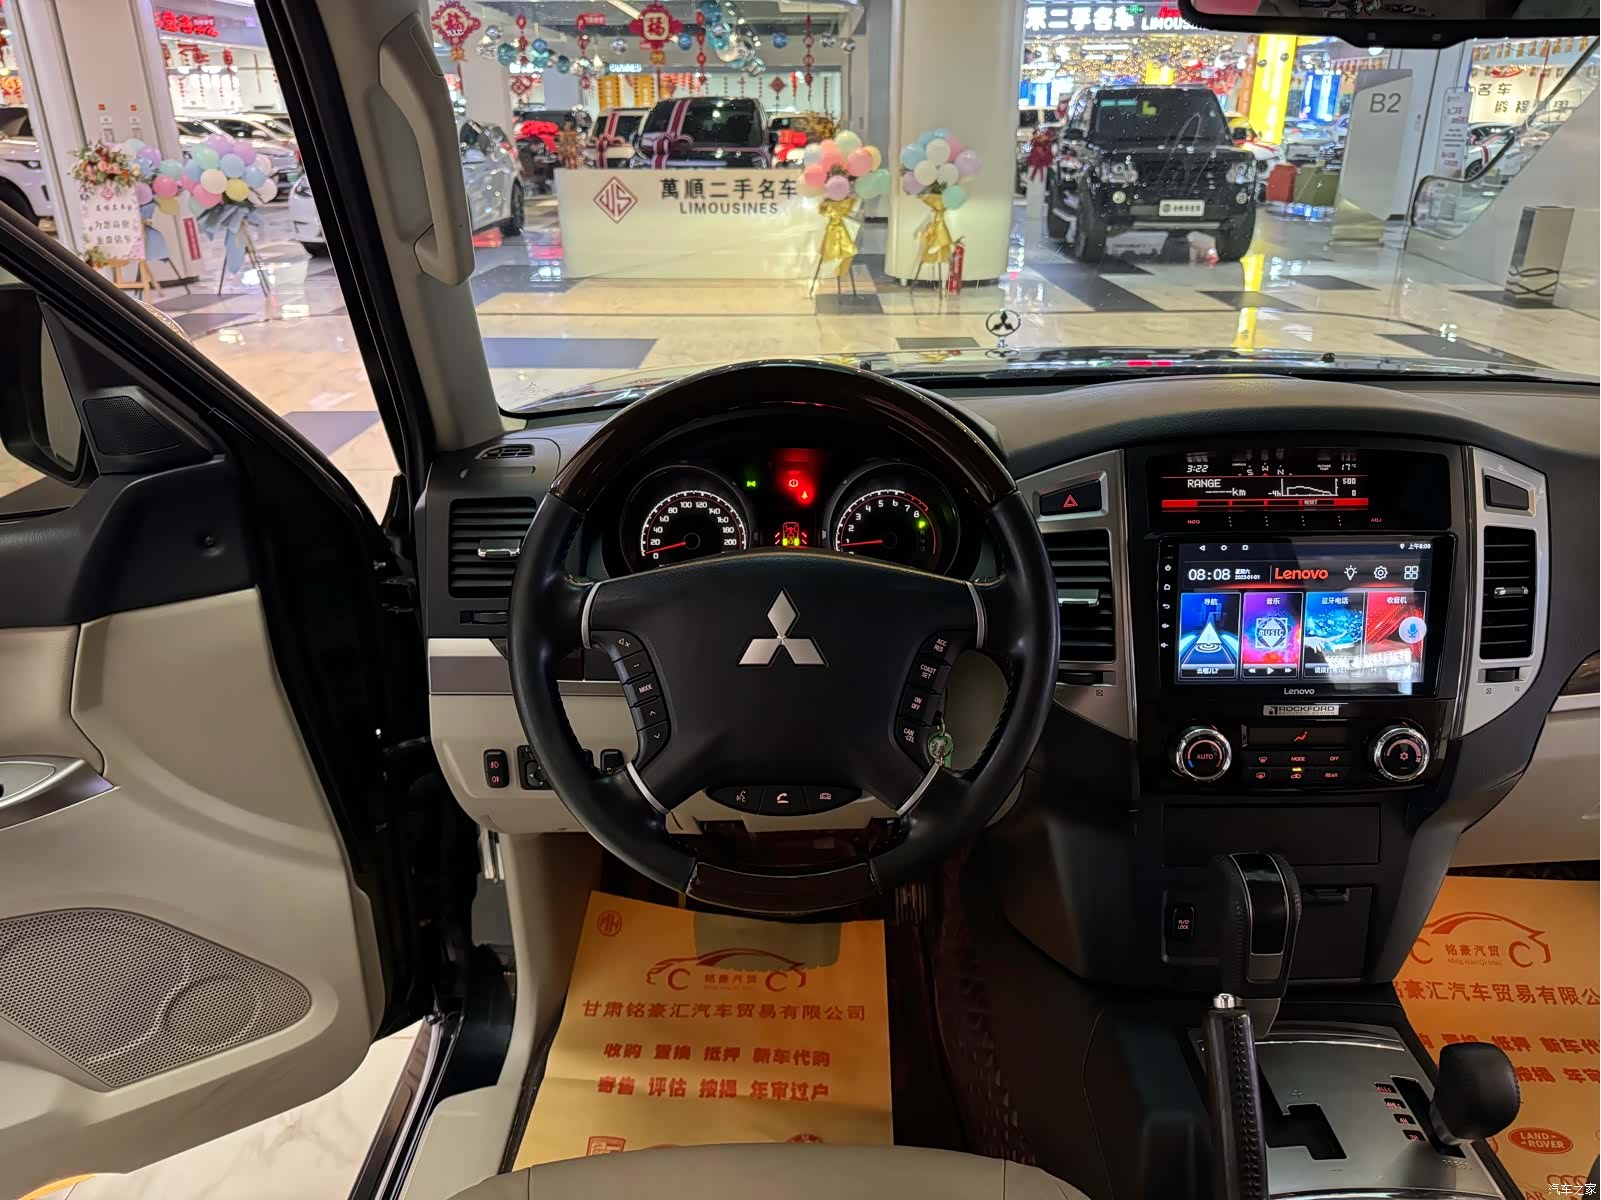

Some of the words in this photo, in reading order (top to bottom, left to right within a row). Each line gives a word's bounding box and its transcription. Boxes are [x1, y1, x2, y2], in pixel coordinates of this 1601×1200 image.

[1370, 93, 1400, 113] B2
[660, 179, 798, 200] 萬順二手名车
[680, 202, 778, 214] LIMOUSINES
[1187, 464, 1209, 473] 3:22
[1277, 468, 1285, 476] N
[1187, 478, 1222, 488] RANGE
[1232, 488, 1247, 497] km
[1351, 489, 1357, 497] 0
[680, 501, 693, 509] 100
[695, 501, 708, 509] 120
[905, 504, 911, 512] 7
[708, 507, 721, 515] 140
[913, 510, 920, 518] 8
[659, 515, 670, 523] 60
[717, 516, 730, 524] 160
[855, 513, 861, 521] 3
[653, 526, 663, 534] 40
[722, 526, 735, 534] 180
[650, 538, 661, 546] 20
[724, 538, 737, 546] 200
[653, 552, 659, 560] 0
[1188, 568, 1231, 581] 08:08
[1275, 568, 1329, 580] Lenovo
[1204, 598, 1219, 606] 导航
[1266, 597, 1281, 605] 音乐
[1321, 596, 1349, 605] 蓝牙电话
[1387, 596, 1408, 604] 收音机
[1258, 628, 1284, 637] MUSIC
[936, 638, 948, 647] ACC
[933, 644, 944, 653] RES
[920, 663, 937, 675] COAST
[921, 671, 932, 680] SET
[638, 683, 654, 694] MODE
[1283, 687, 1315, 695] Lenovo
[914, 696, 923, 704] ON
[910, 702, 920, 711] OFF
[903, 727, 915, 736] CAN
[1196, 753, 1214, 761] AUTO
[1444, 943, 1500, 957] 铭豪汽贸
[582, 999, 866, 1021] 甘肃铭豪汇汽车贸易有限公司
[603, 1042, 643, 1059] 收购
[704, 1046, 741, 1062] 抵押
[753, 1047, 831, 1067] 新车代购
[597, 1075, 636, 1096] 寄售
[648, 1077, 687, 1098] 评估
[699, 1078, 738, 1099] 按揭
[750, 1080, 829, 1102] 年审过户
